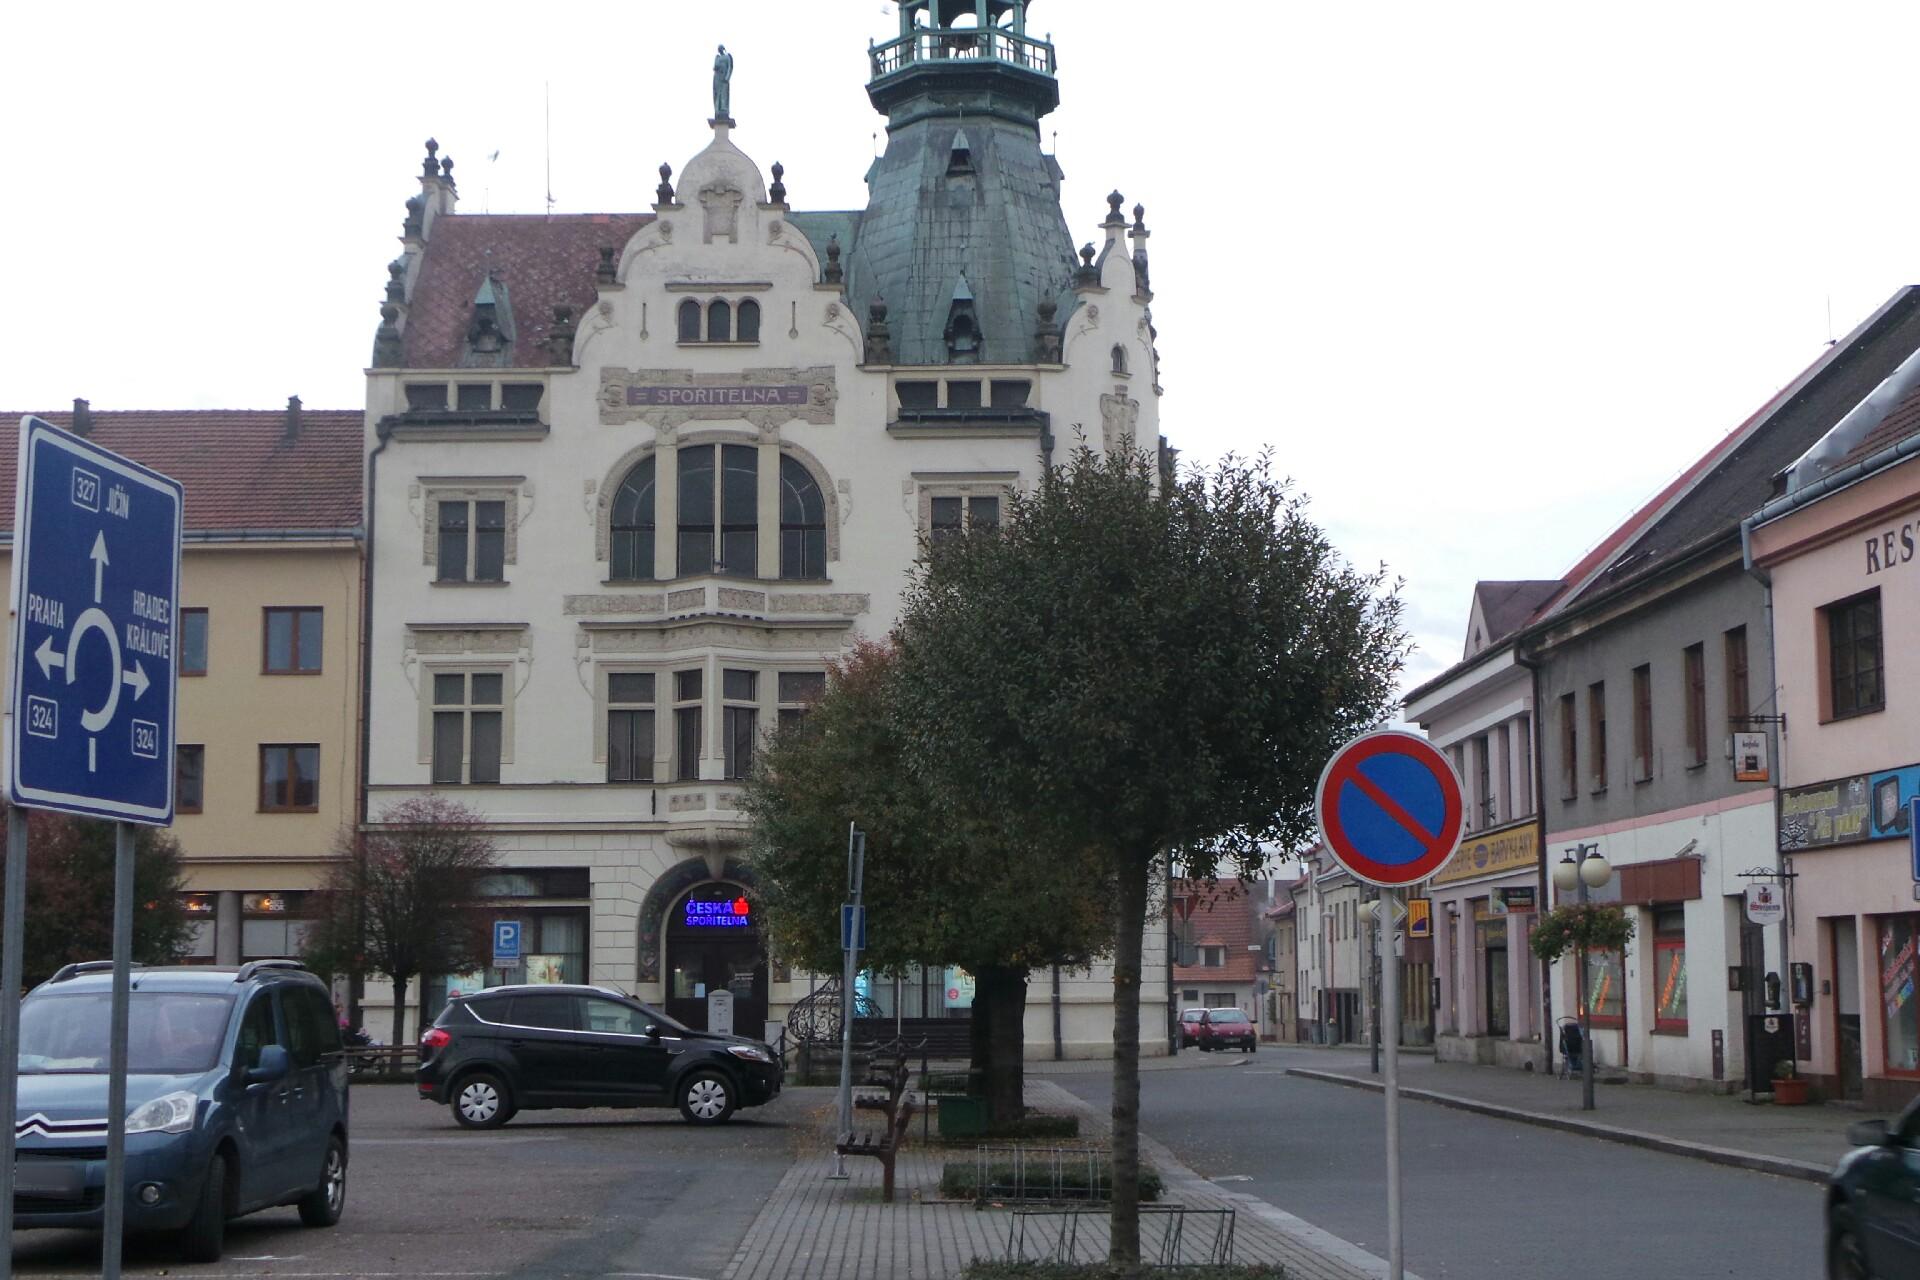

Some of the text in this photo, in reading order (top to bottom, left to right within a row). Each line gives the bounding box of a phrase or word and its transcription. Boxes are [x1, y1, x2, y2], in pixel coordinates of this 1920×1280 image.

[77, 477, 95, 502] 327
[106, 484, 129, 519] JIČÍN
[1865, 520, 1920, 575] RES
[28, 593, 64, 629] PRAHA
[133, 590, 169, 624] HRADEC
[126, 622, 169, 659] KRÁLOVÉ
[32, 705, 52, 730] 324
[136, 728, 154, 750] 324
[686, 899, 733, 914] ČESKÁ
[686, 914, 748, 926] SPOŘITELNA
[499, 926, 515, 947] P
